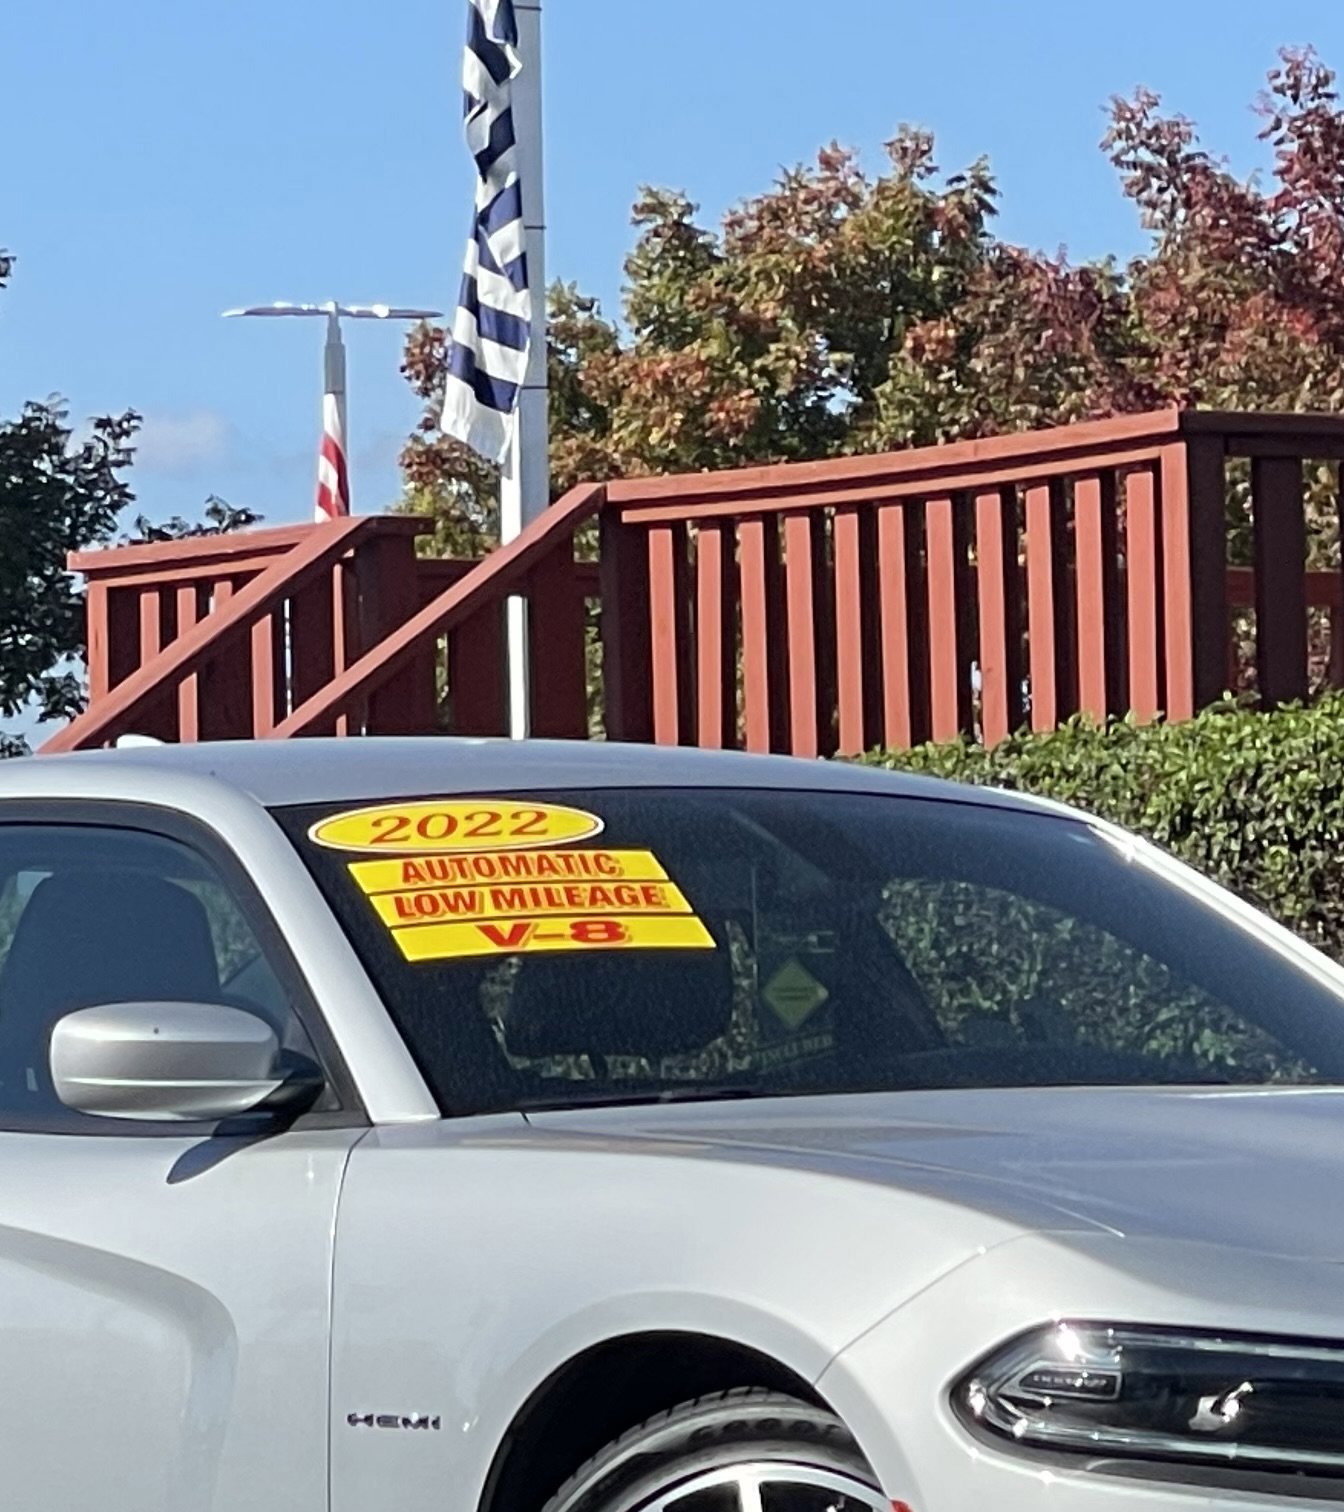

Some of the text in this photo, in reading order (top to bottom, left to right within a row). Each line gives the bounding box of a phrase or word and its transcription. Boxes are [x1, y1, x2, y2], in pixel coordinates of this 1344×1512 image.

[369, 810, 549, 845] 2022
[402, 853, 620, 884] AUTOMATIC
[394, 885, 664, 918] LOW MILEAGE
[476, 920, 628, 947] V-8
[346, 1412, 441, 1431] HEMI
